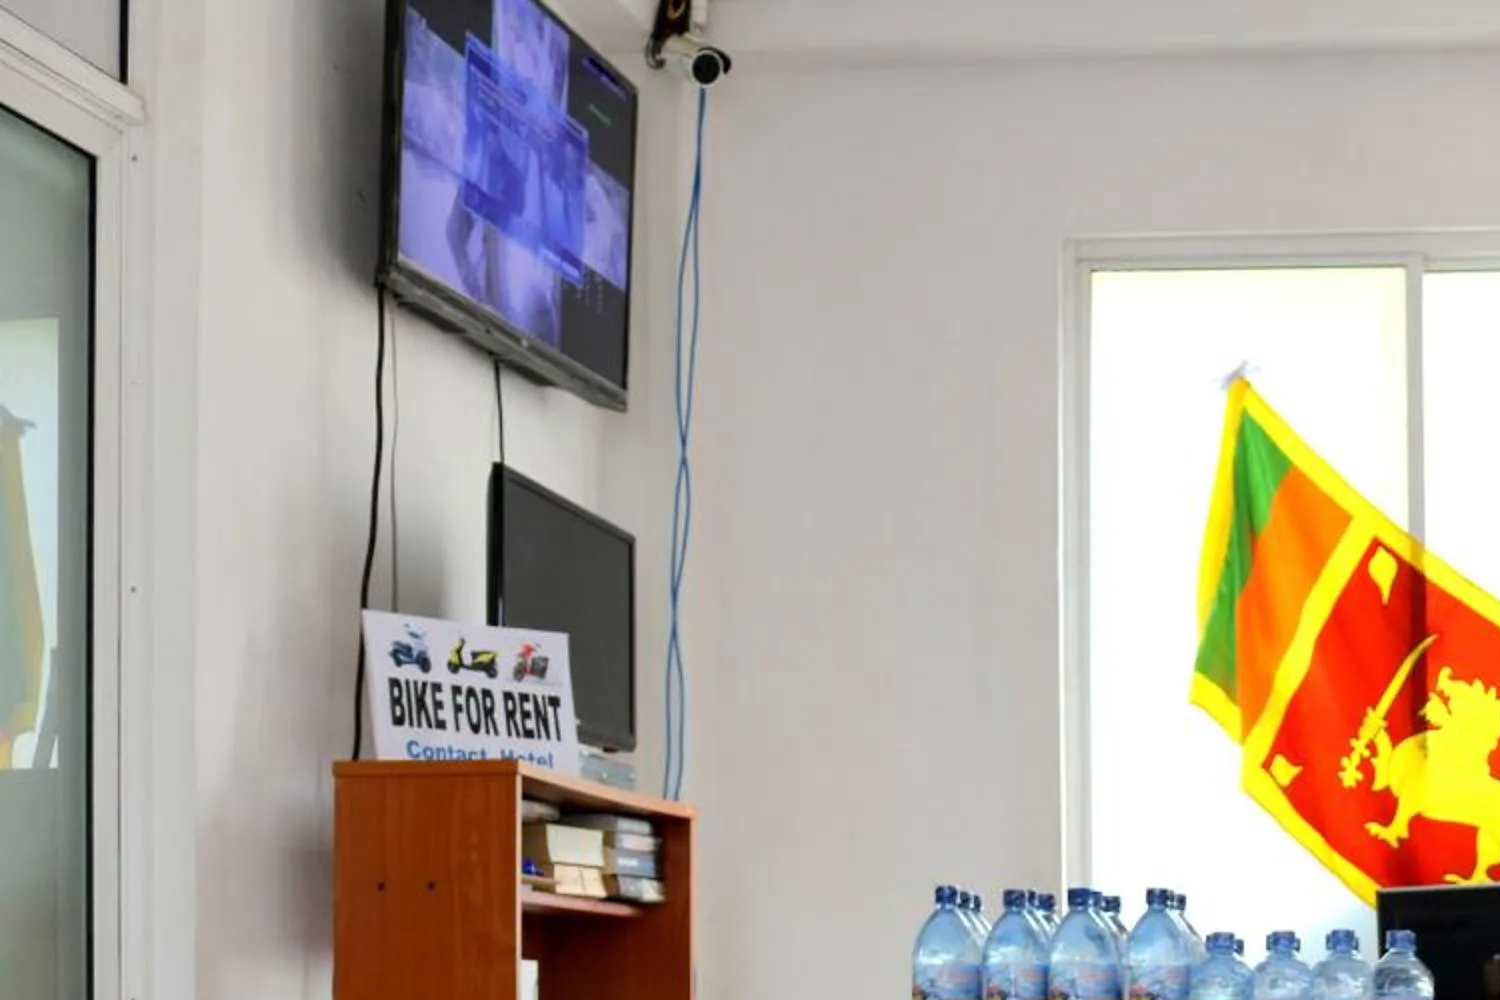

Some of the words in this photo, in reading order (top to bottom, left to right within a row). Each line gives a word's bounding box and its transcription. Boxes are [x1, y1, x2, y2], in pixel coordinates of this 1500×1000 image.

[388, 677, 447, 731] BIKE
[451, 685, 499, 737] FOR
[502, 691, 562, 742] RENT
